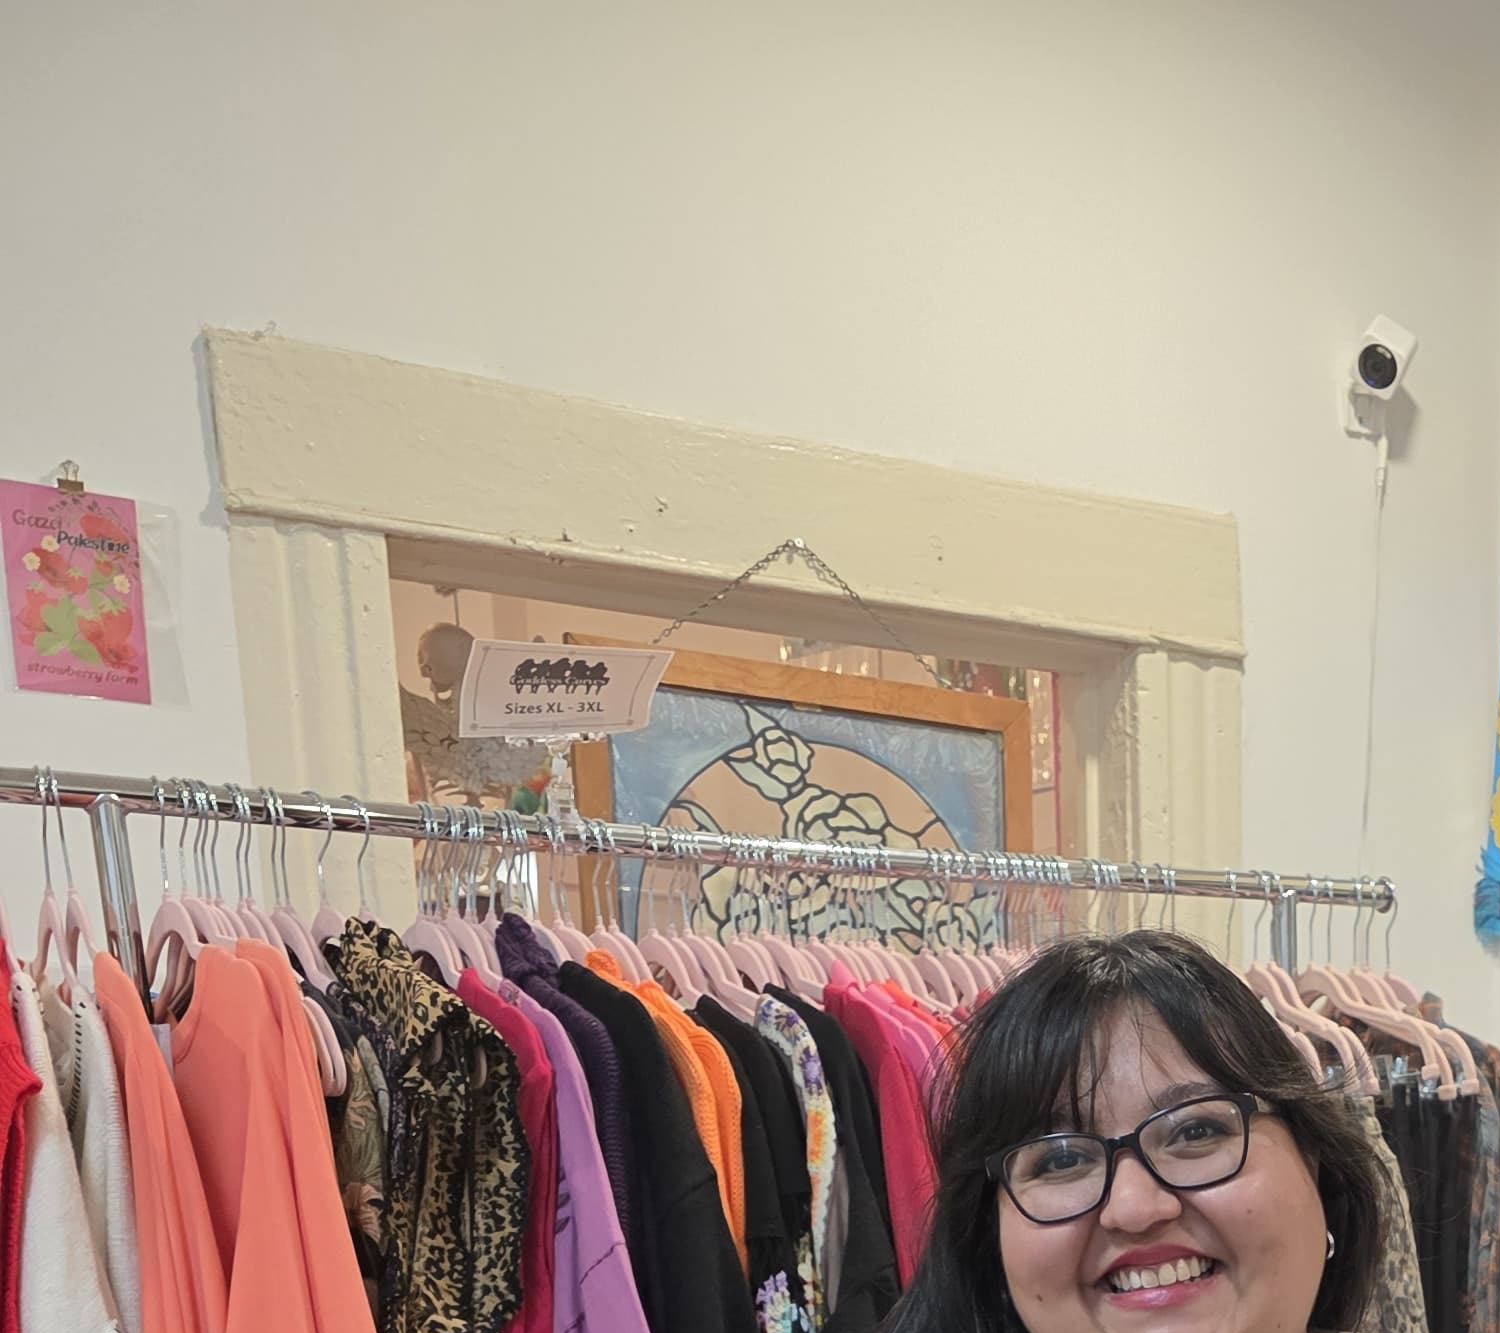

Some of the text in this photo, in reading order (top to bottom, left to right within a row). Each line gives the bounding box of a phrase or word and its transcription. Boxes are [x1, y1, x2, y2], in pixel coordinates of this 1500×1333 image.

[27, 663, 138, 686] strawberry farm
[504, 702, 542, 714] Sizes
[546, 702, 564, 713] XL
[577, 701, 604, 713] 3XL
